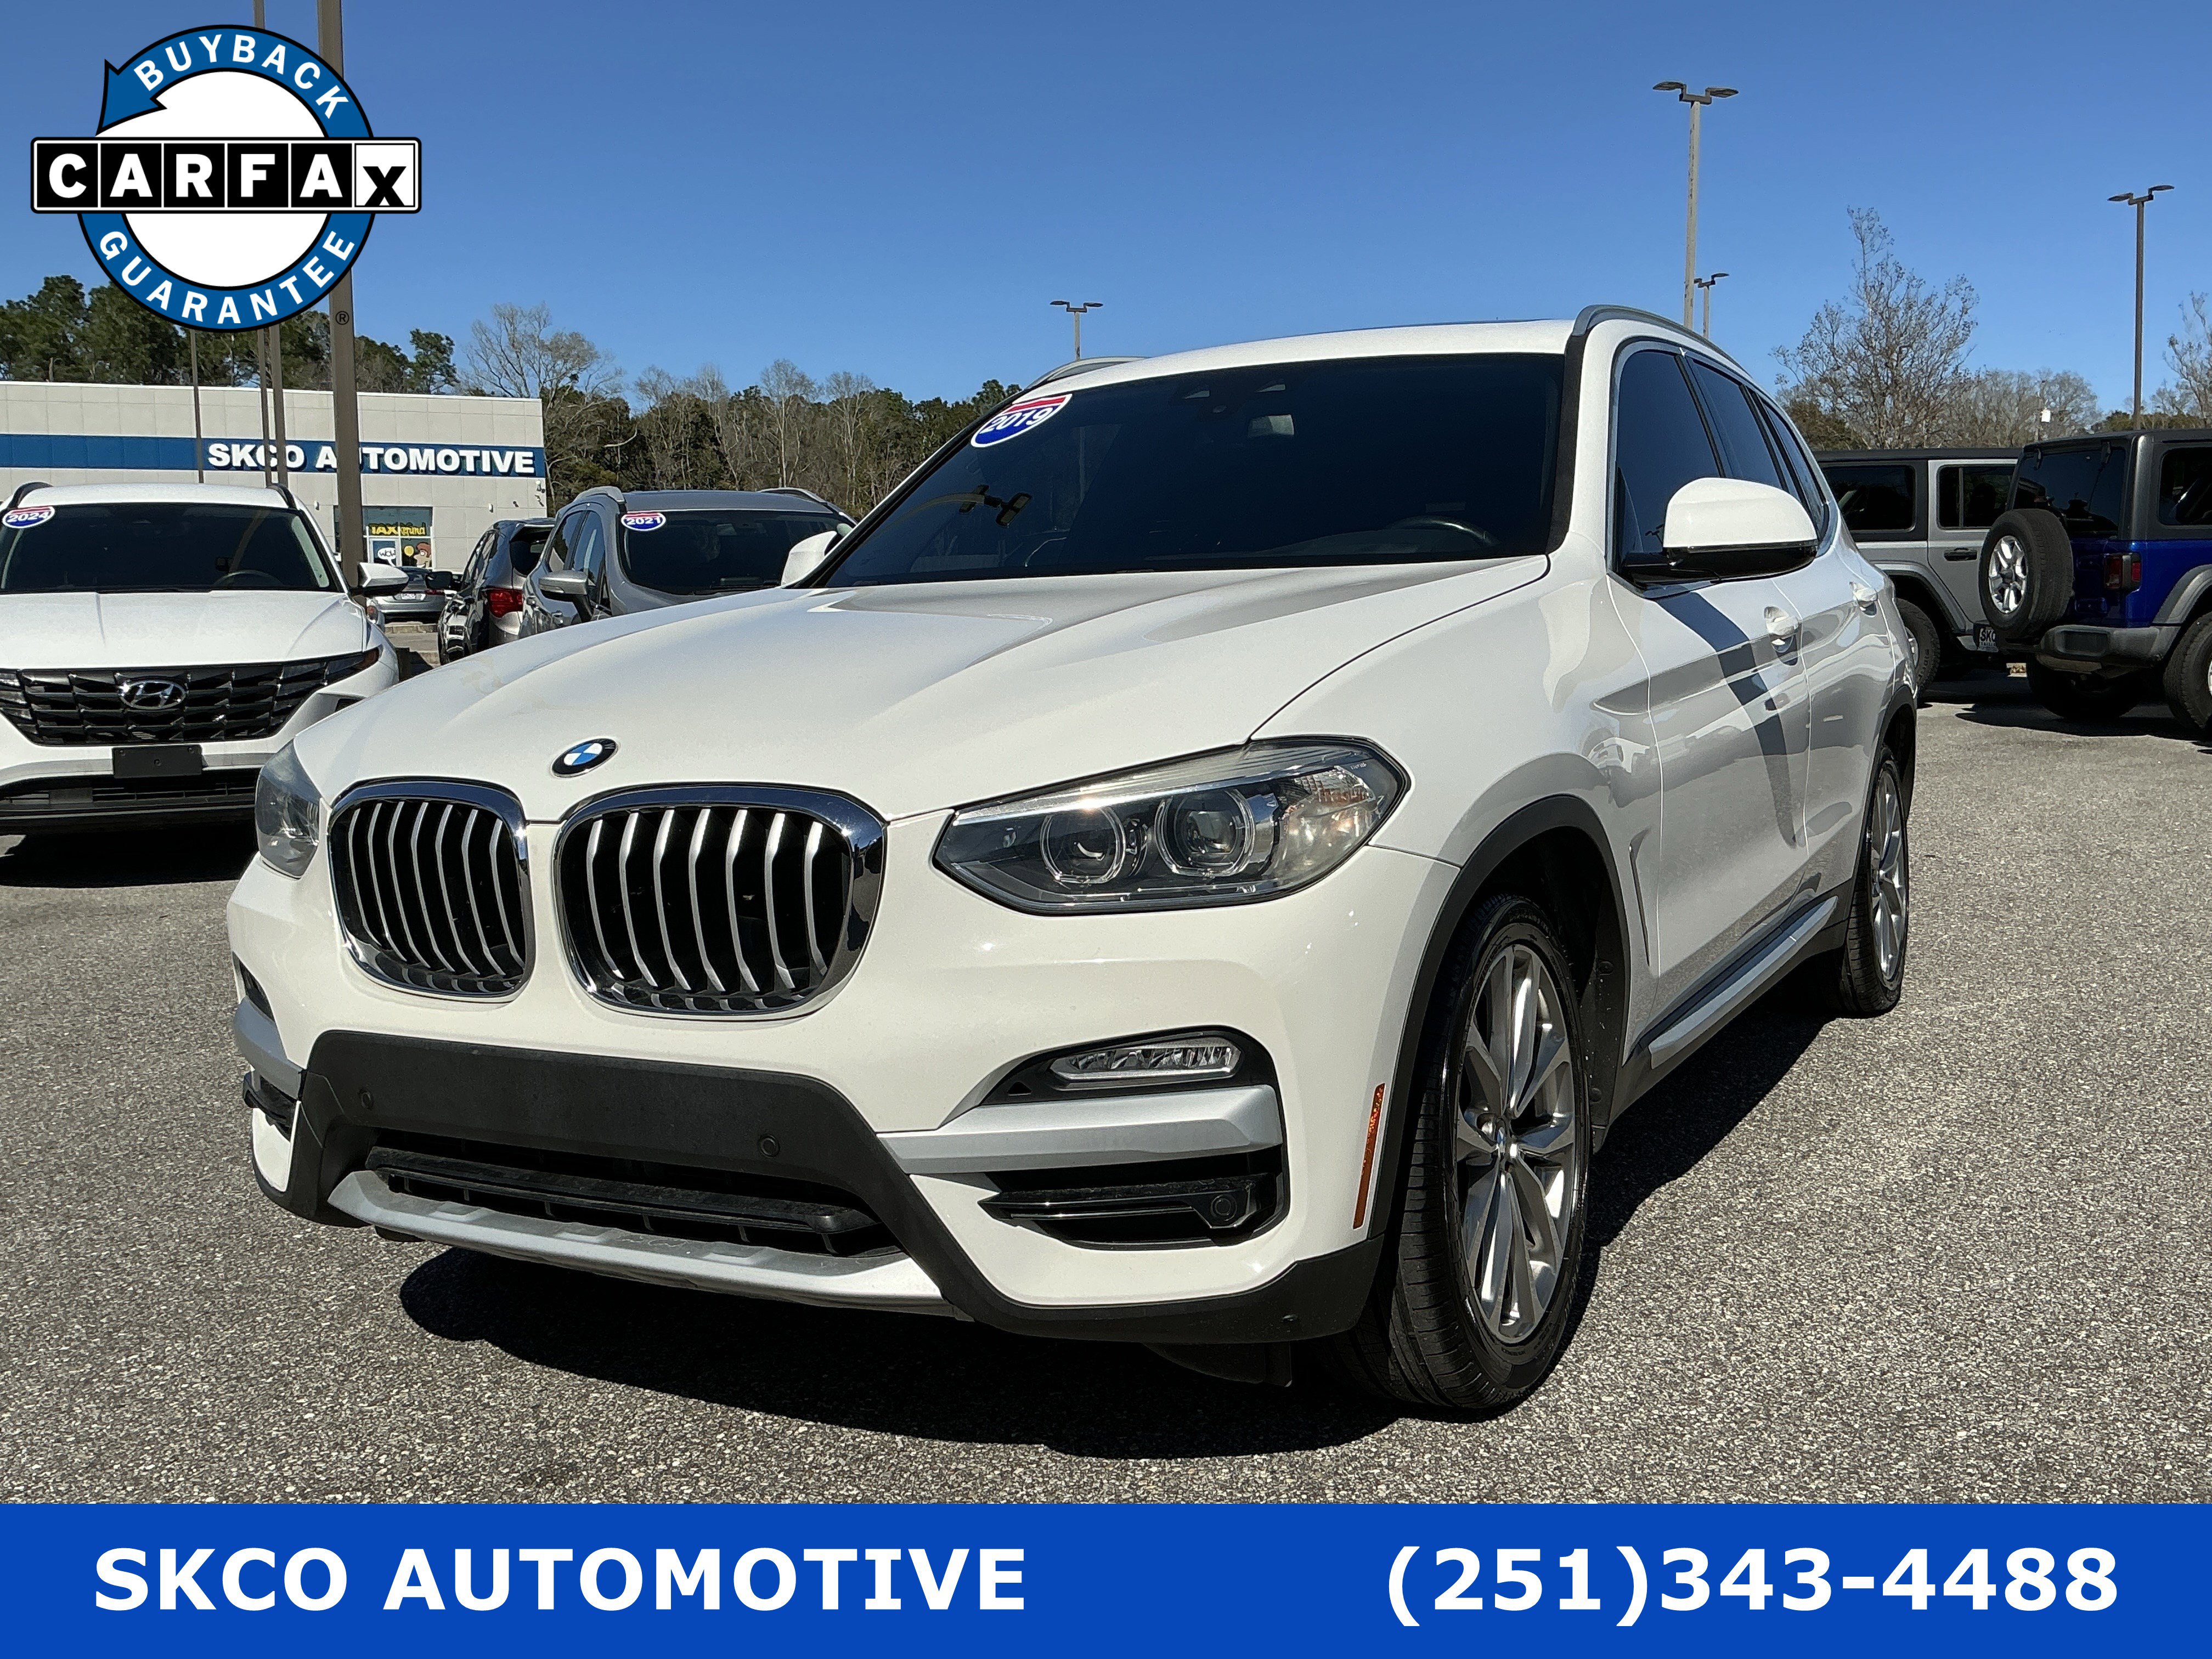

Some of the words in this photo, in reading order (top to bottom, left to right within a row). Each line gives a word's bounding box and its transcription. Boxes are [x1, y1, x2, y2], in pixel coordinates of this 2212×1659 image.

[979, 407, 1053, 434] 2019
[208, 443, 304, 468] SKCO
[315, 446, 535, 473] ATOMOTIVE
[7, 511, 49, 522] 2024
[627, 517, 661, 525] 2021
